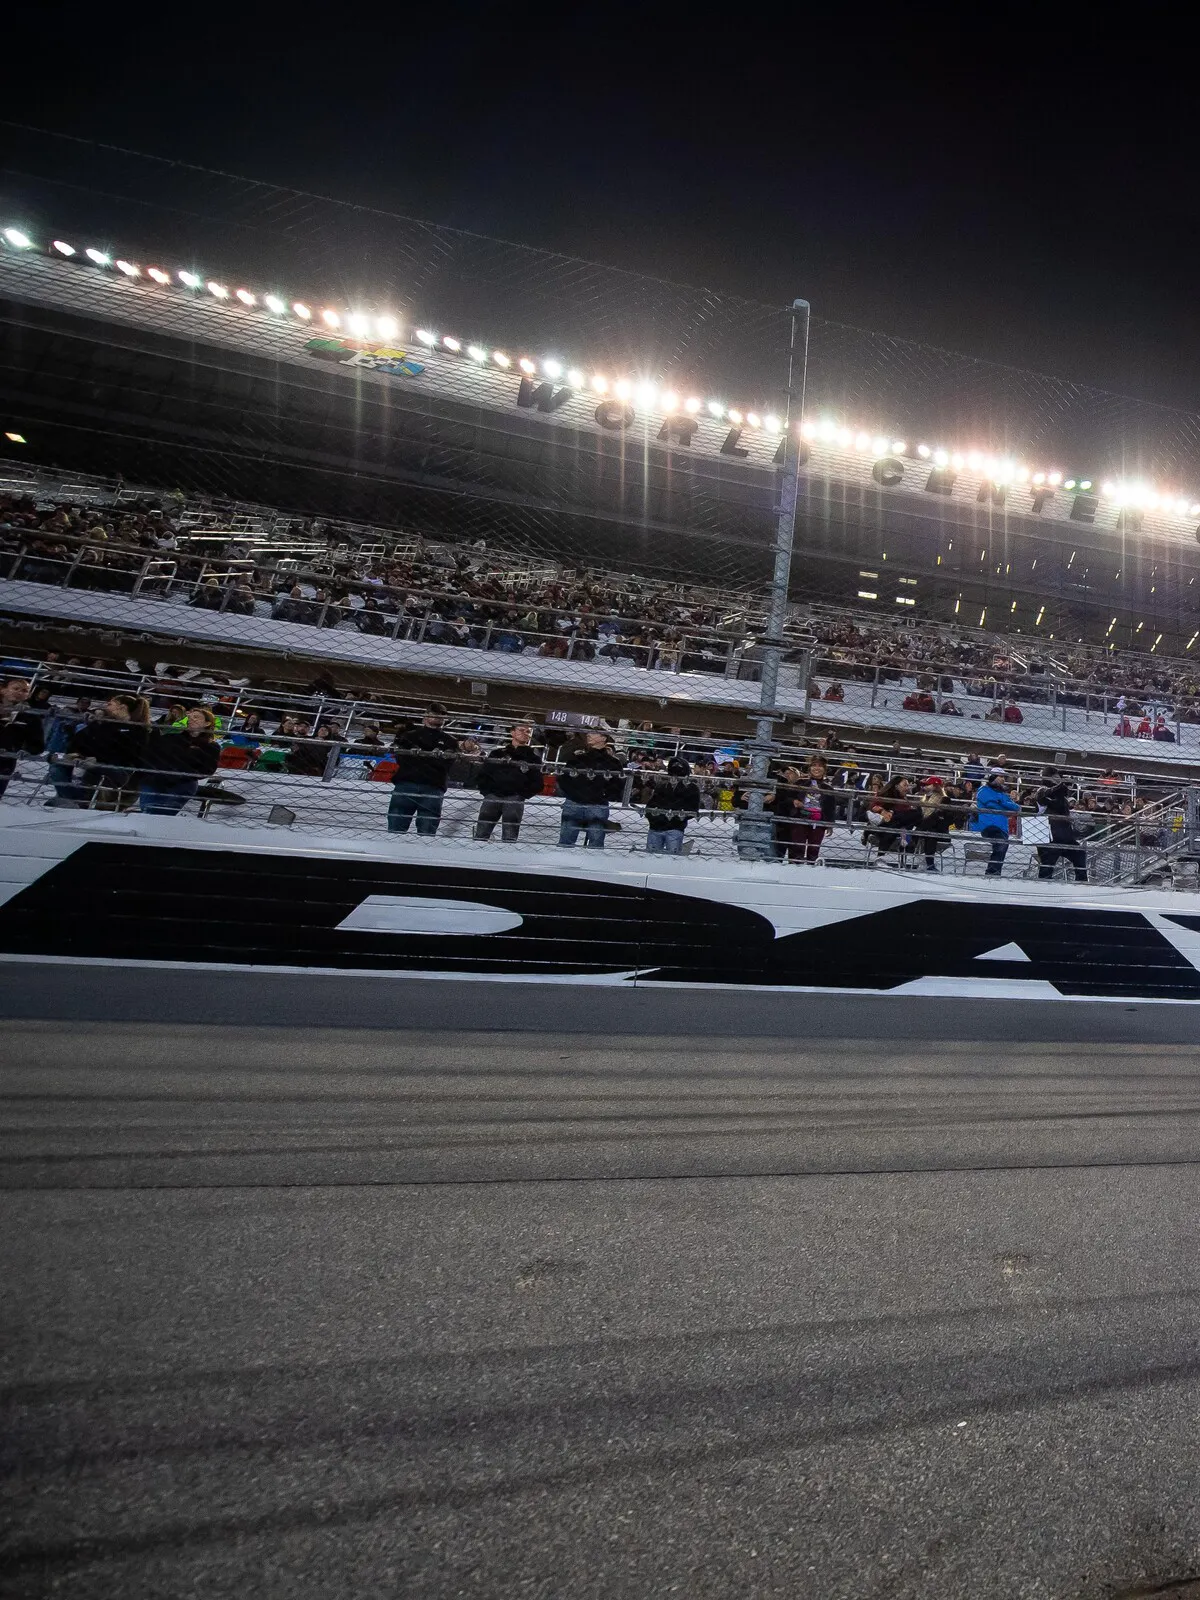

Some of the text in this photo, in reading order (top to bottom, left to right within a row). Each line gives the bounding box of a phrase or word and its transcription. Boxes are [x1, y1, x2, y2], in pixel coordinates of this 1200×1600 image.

[551, 711, 595, 726] 148 147
[842, 770, 870, 789] 17
